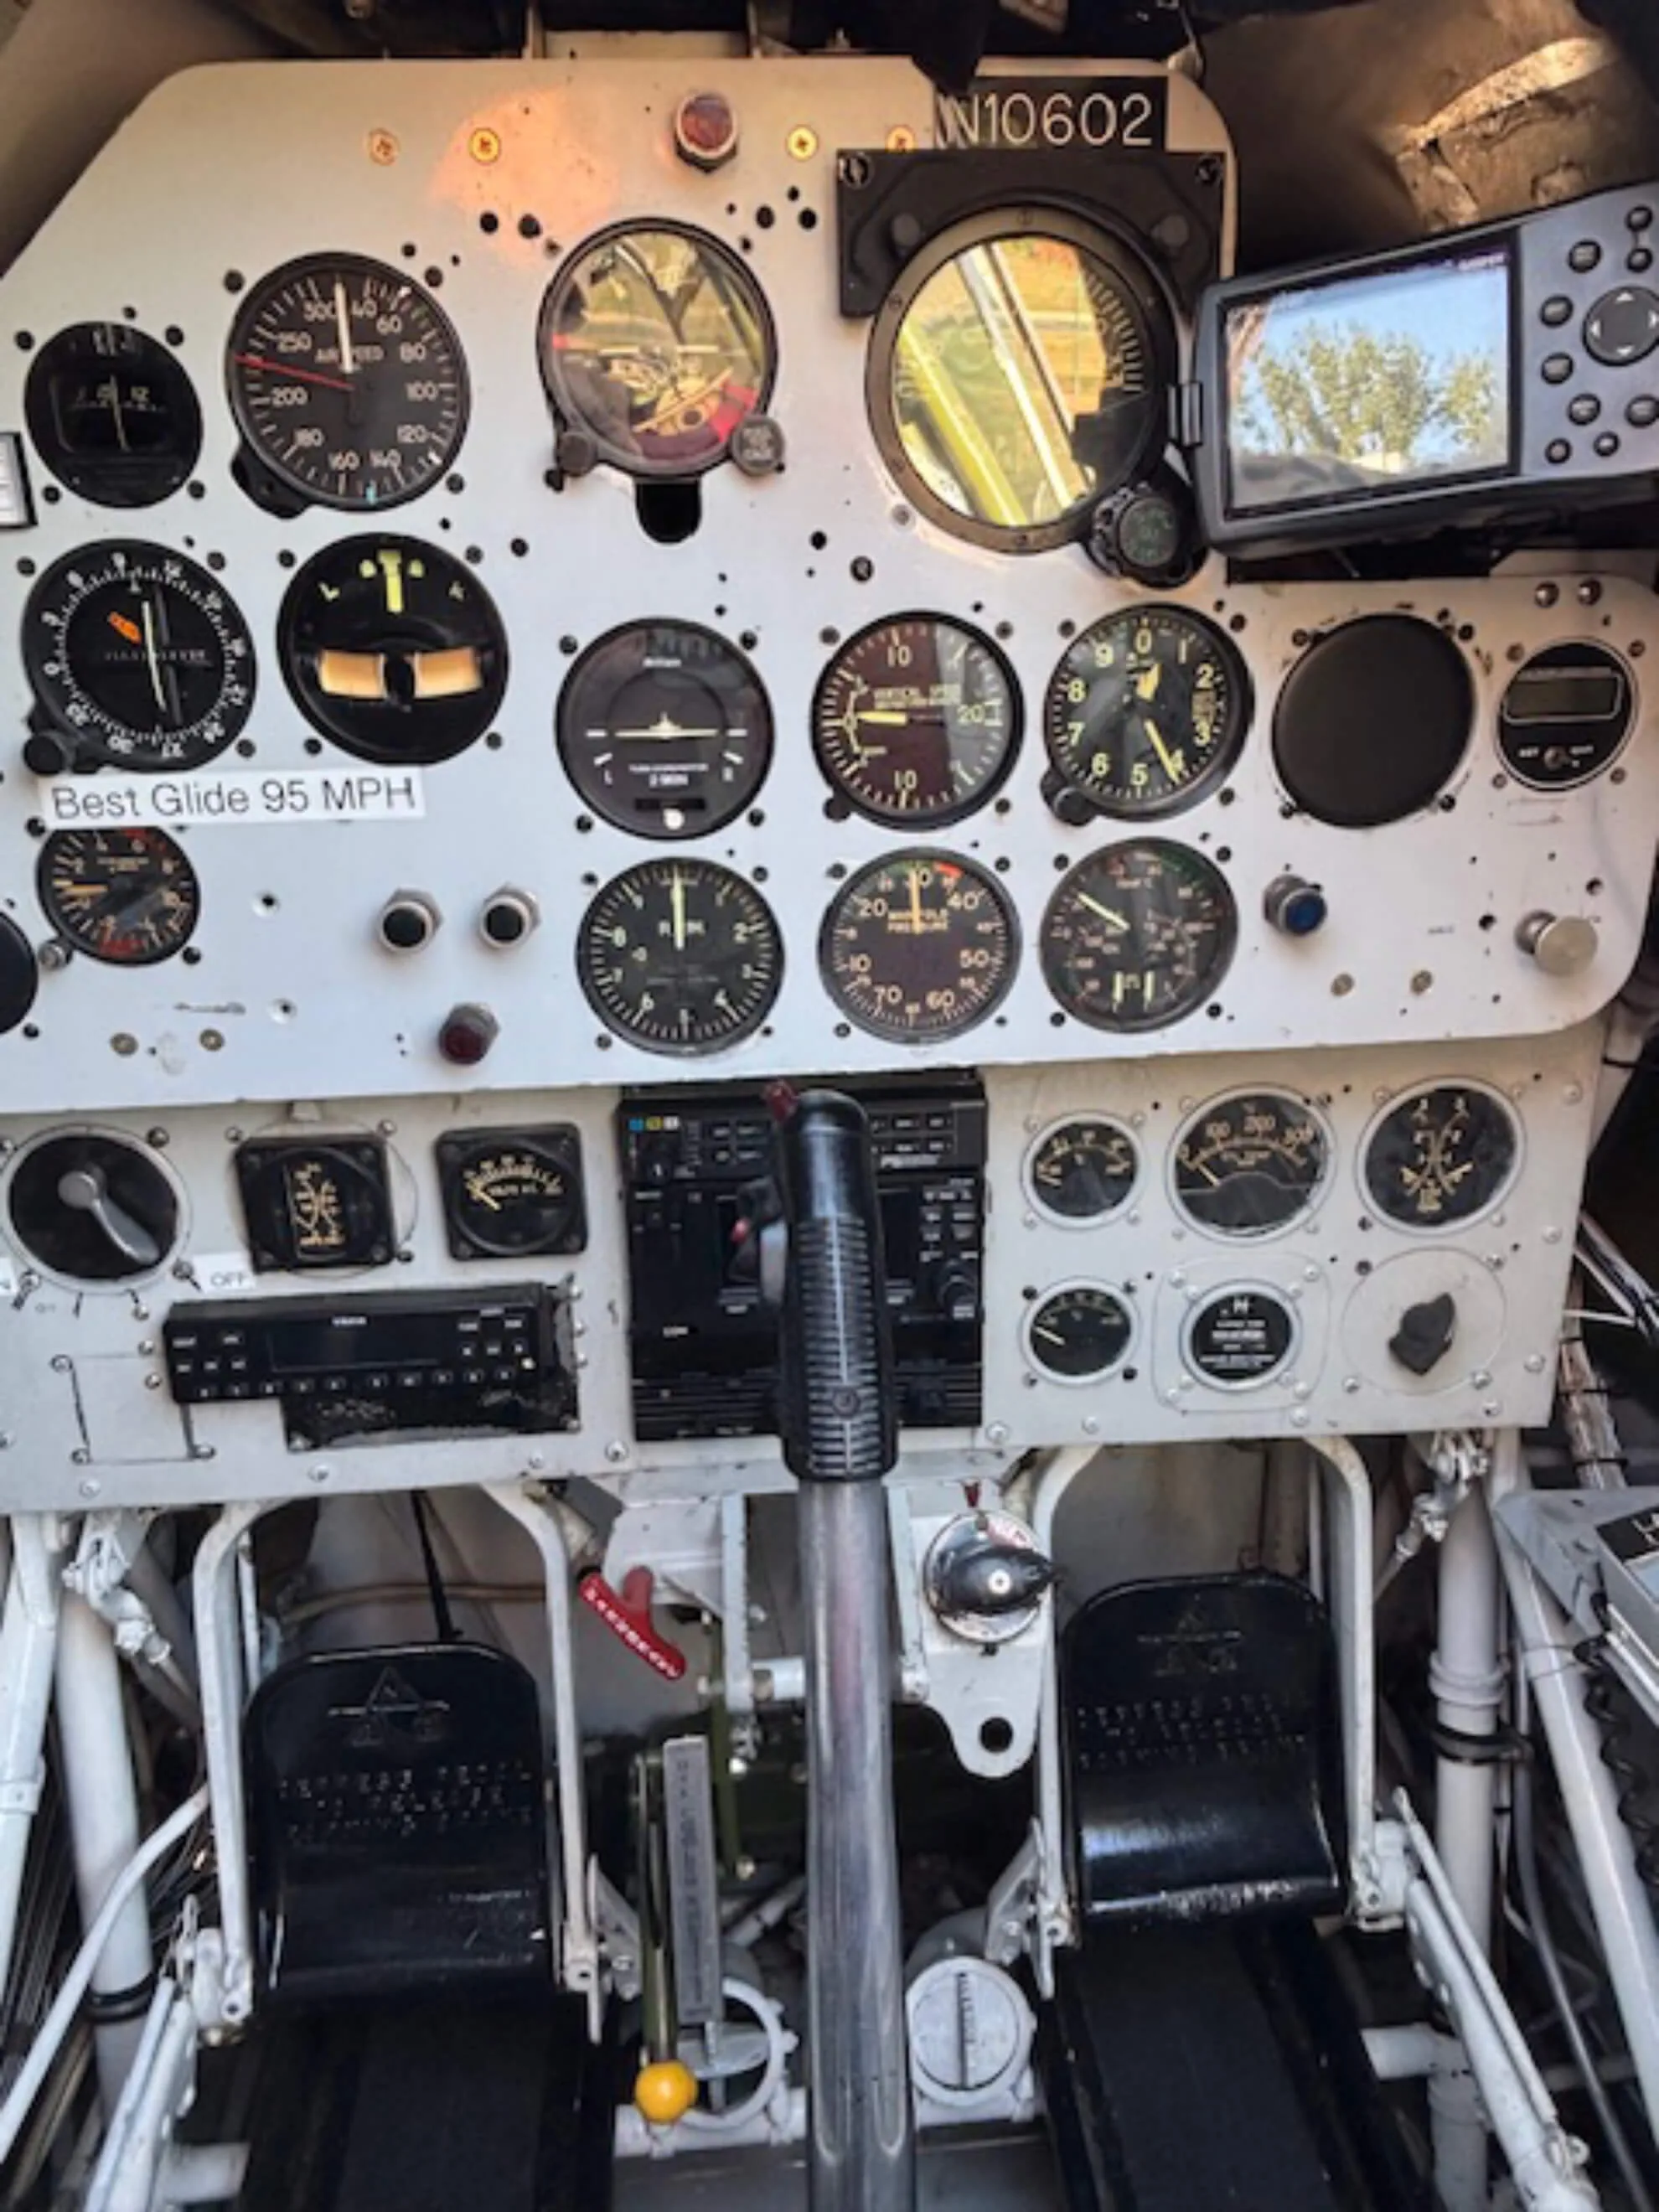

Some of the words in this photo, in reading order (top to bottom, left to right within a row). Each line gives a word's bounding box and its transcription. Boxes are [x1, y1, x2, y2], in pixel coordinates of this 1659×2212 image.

[945, 91, 1153, 149] N10602
[351, 299, 377, 318] 40
[377, 314, 402, 334] 60
[277, 332, 312, 353] 250
[400, 343, 426, 363] 80
[271, 386, 308, 406] 200
[406, 381, 438, 401] 100
[294, 428, 324, 447] 180
[396, 425, 428, 444] 120
[328, 450, 361, 470] 160
[370, 449, 401, 469] 140
[318, 581, 340, 602] L
[1135, 628, 1152, 654] 0
[887, 645, 912, 667] 10
[1094, 643, 1114, 668] 9
[1196, 664, 1215, 688] 2
[1067, 677, 1087, 703] 8
[958, 704, 985, 725] 20
[1067, 721, 1086, 747] 7
[1193, 721, 1212, 745] 3
[1092, 752, 1110, 777] 6
[1131, 762, 1149, 786] 5
[894, 769, 917, 790] 10
[51, 786, 141, 820] Best
[151, 781, 251, 816] Glide
[261, 779, 309, 814] 95
[322, 776, 416, 811] MPH
[860, 897, 888, 917] 20
[947, 892, 979, 911] 40
[732, 923, 748, 943] 2
[849, 954, 872, 974] 10
[960, 948, 990, 969] 50
[874, 985, 902, 1005] 70
[927, 989, 955, 1010] 60
[210, 1272, 245, 1288] OFF
